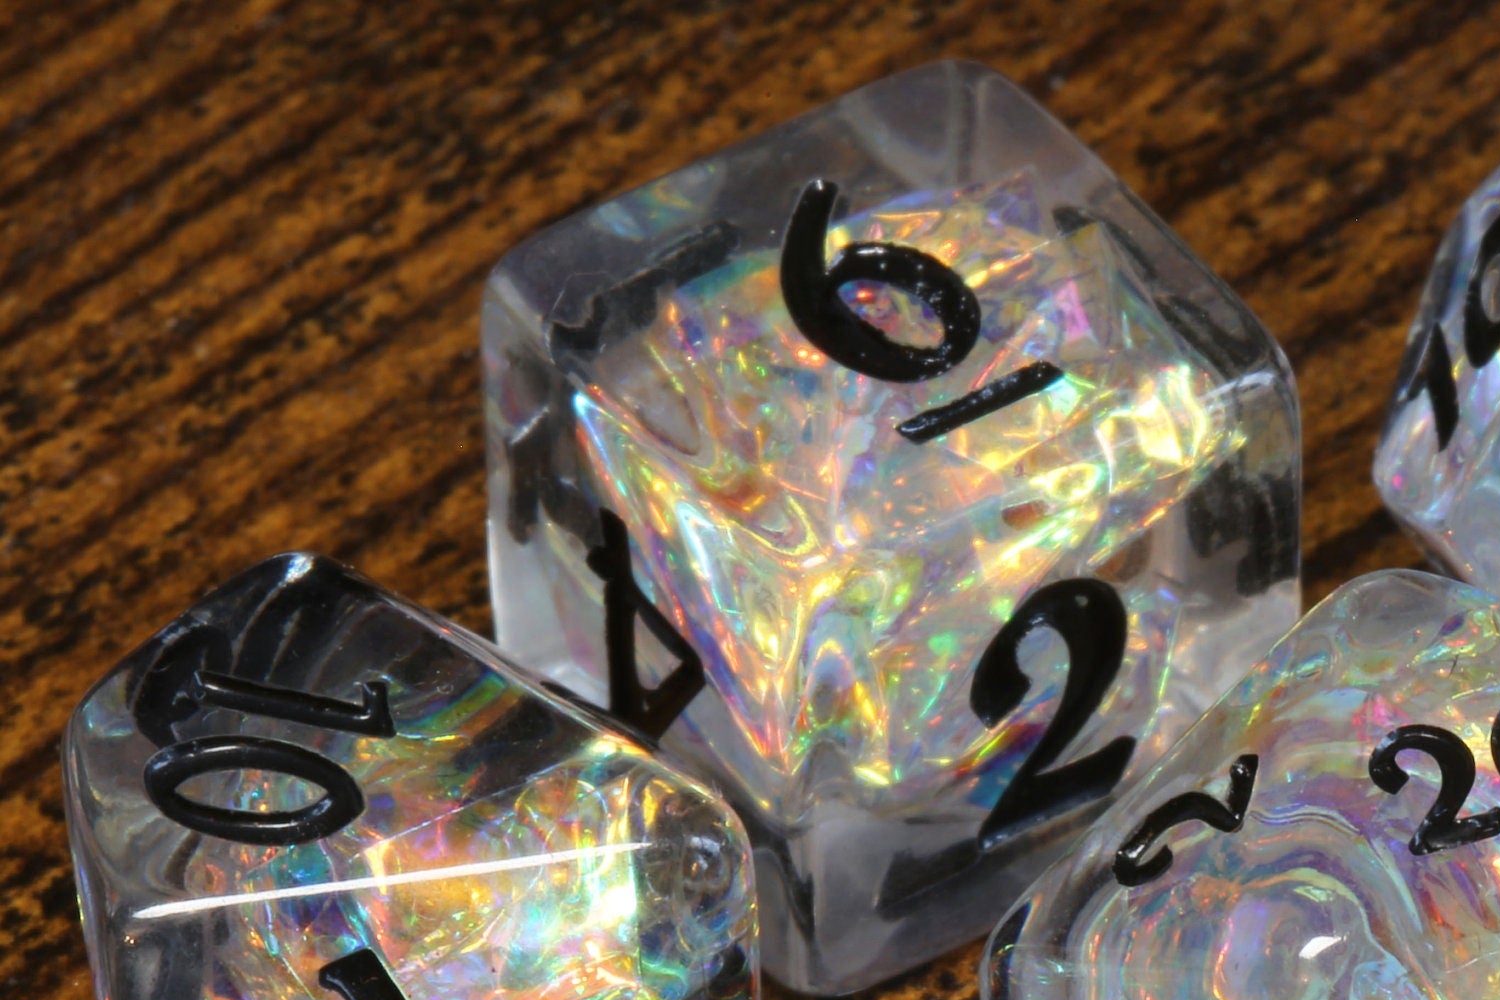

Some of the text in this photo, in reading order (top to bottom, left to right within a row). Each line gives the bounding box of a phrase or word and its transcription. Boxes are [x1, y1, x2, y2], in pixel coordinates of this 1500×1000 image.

[780, 178, 982, 382] 6
[143, 668, 396, 846] 10
[970, 578, 1136, 850] 2
[1113, 754, 1258, 886] 2
